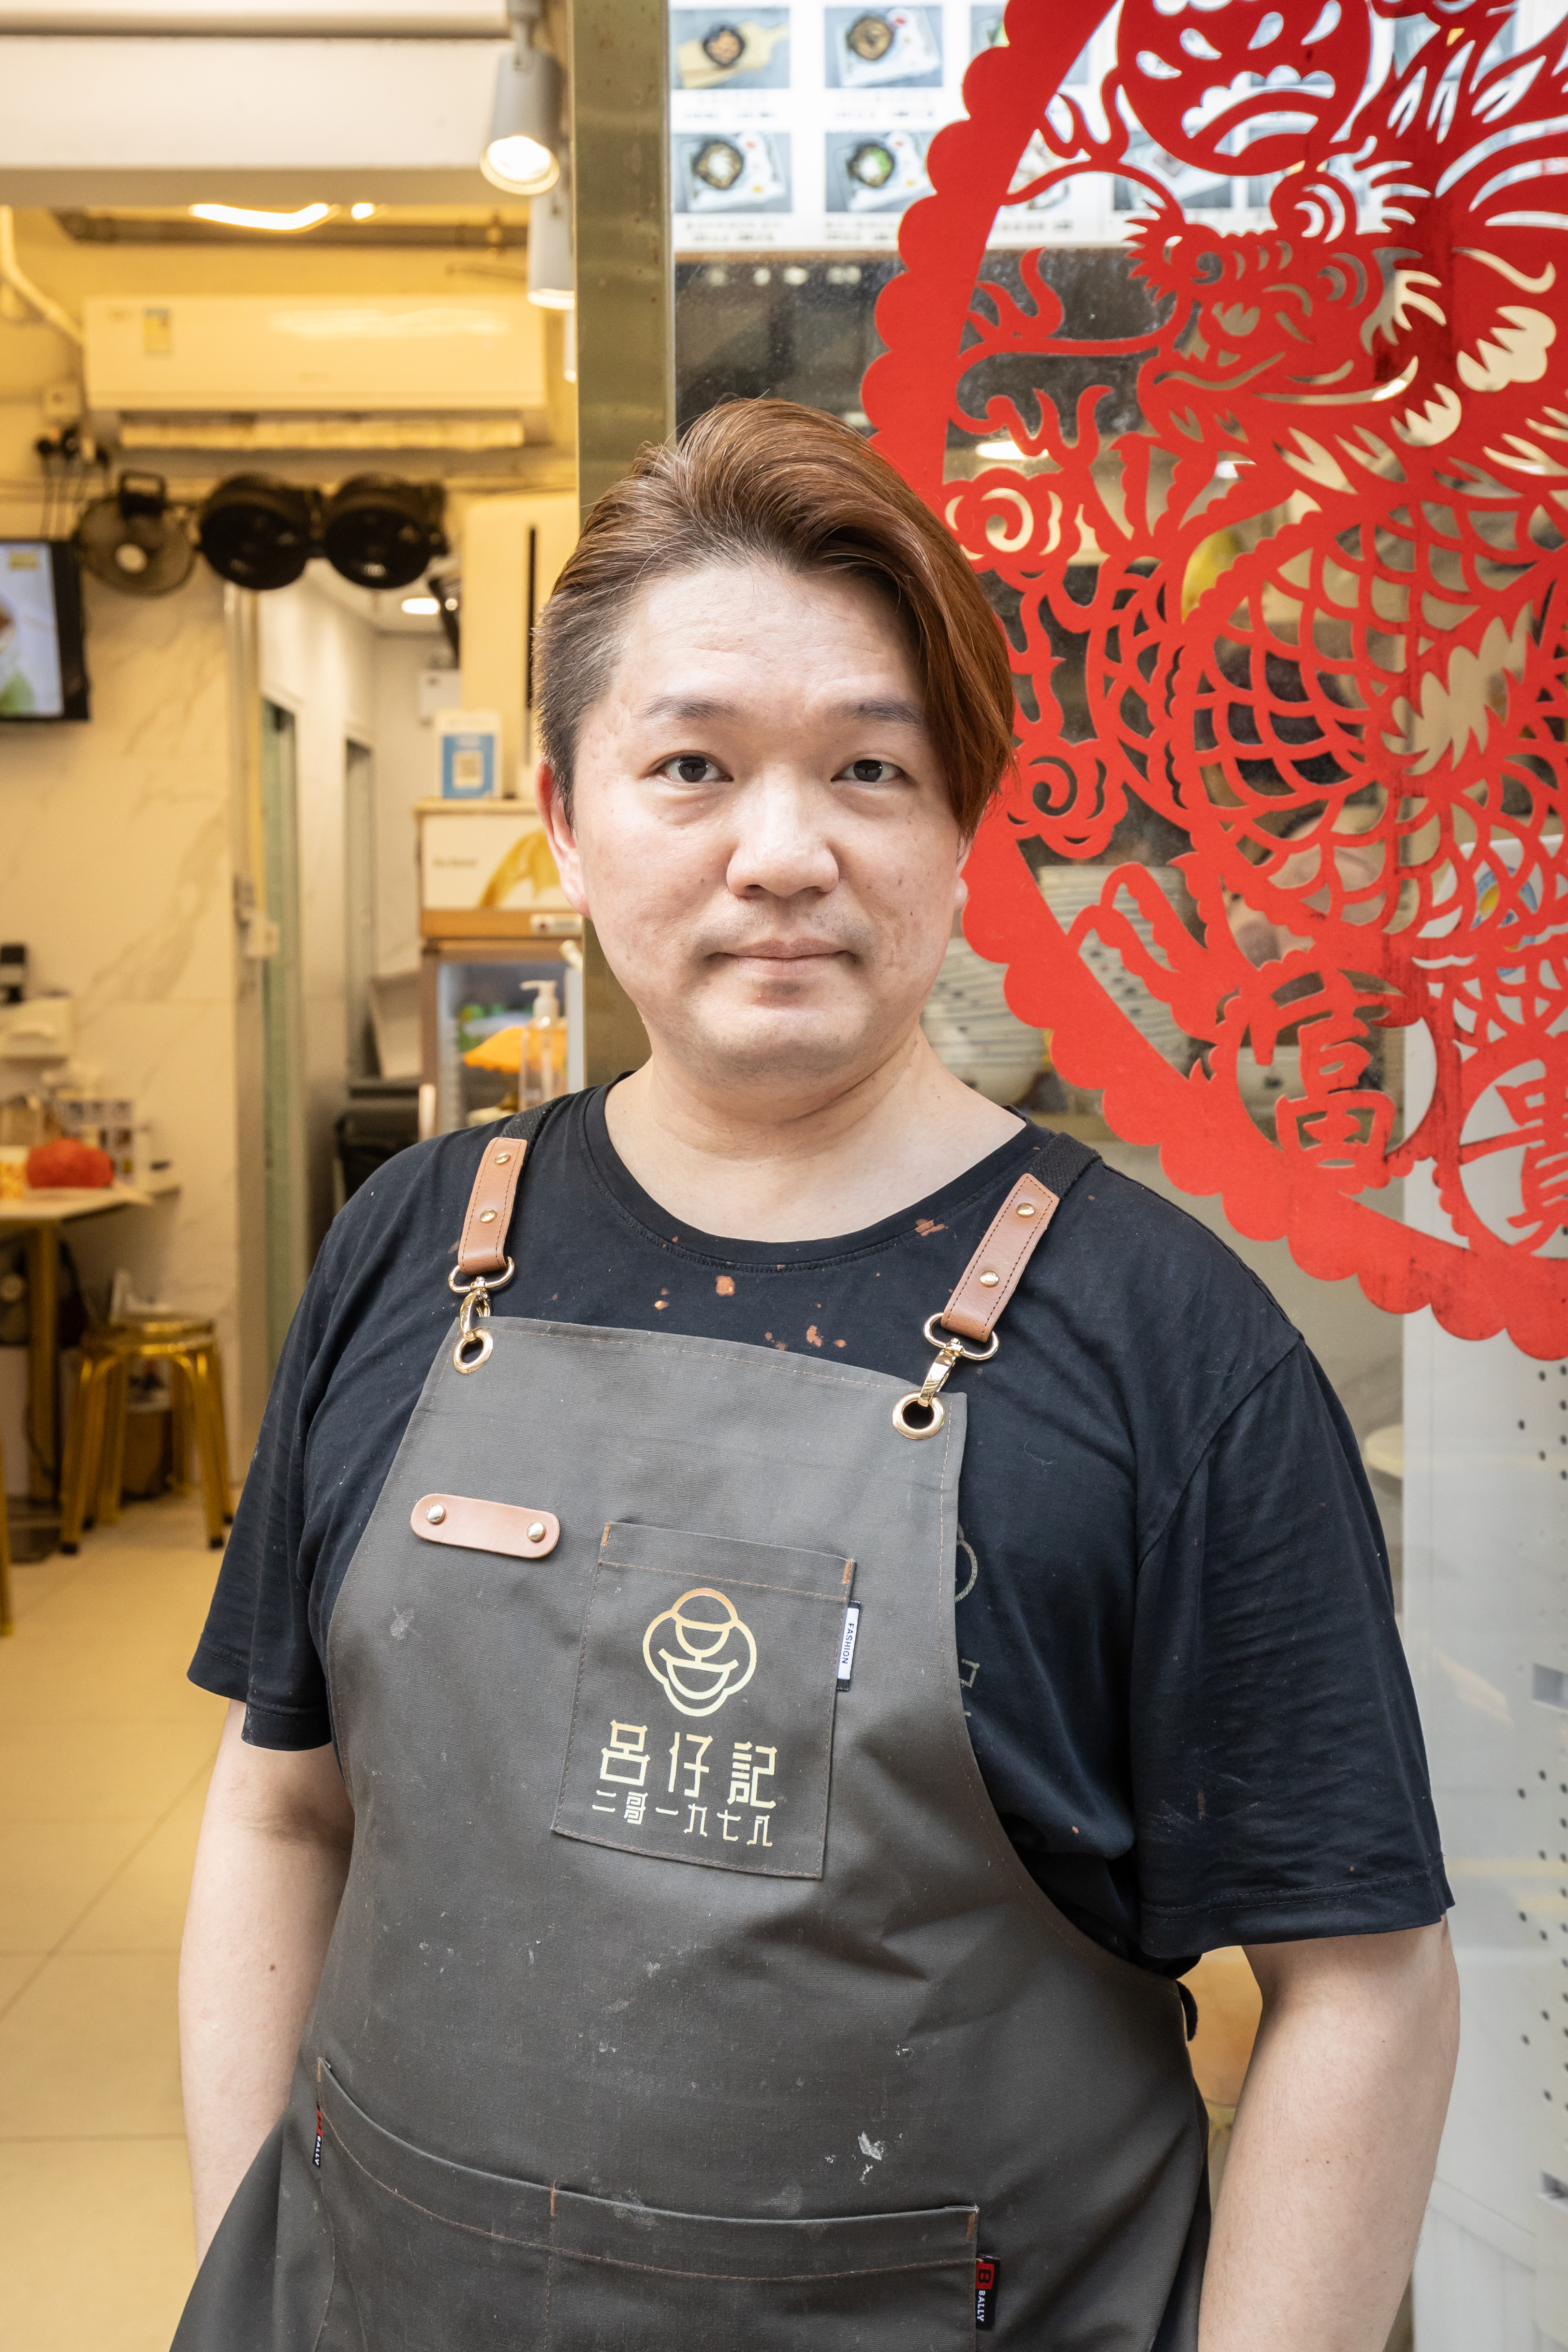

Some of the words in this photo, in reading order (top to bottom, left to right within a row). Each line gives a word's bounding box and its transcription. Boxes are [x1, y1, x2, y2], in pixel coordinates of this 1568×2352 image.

[842, 1623, 854, 1664] FASHION
[600, 1720, 777, 1809] 呂仔記
[978, 2268, 992, 2284] B
[977, 2290, 985, 2322] BALLY
